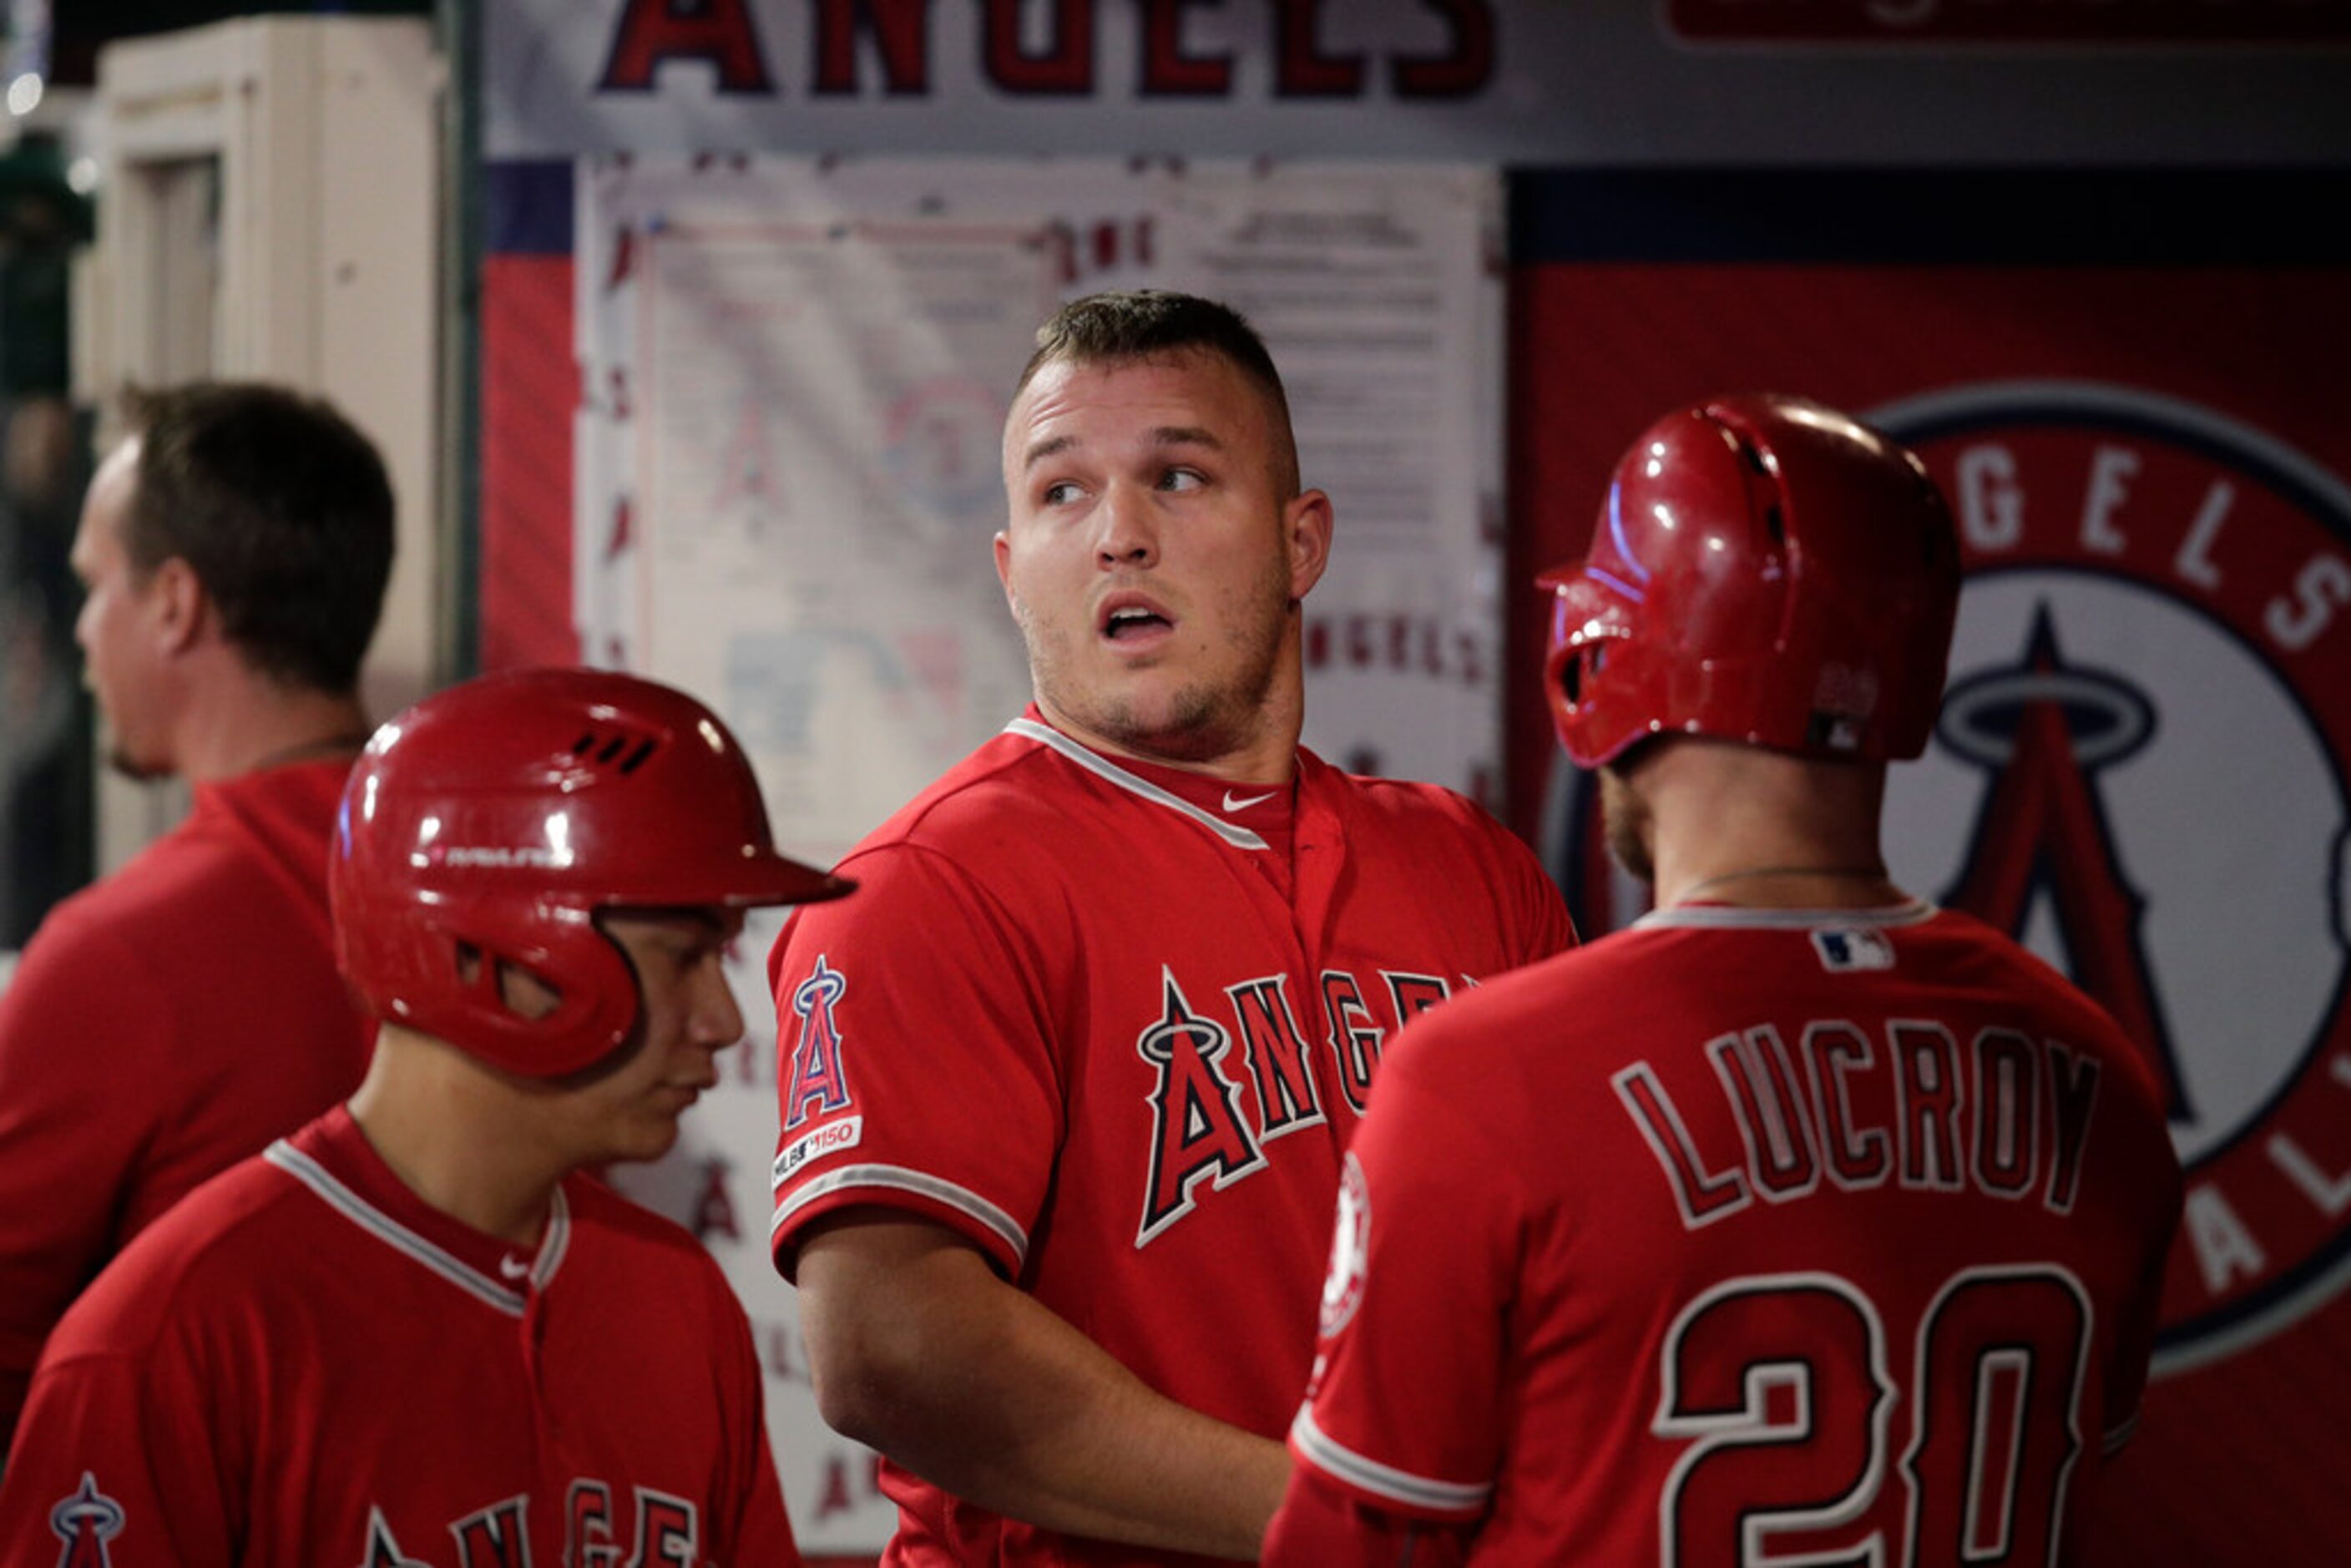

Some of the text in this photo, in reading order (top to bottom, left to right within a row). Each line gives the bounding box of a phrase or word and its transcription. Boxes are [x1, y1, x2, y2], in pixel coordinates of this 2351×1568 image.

[1955, 443, 2351, 651] GELS
[1610, 1019, 2101, 1231] LUCROY
[1650, 1262, 2095, 1568] 20
